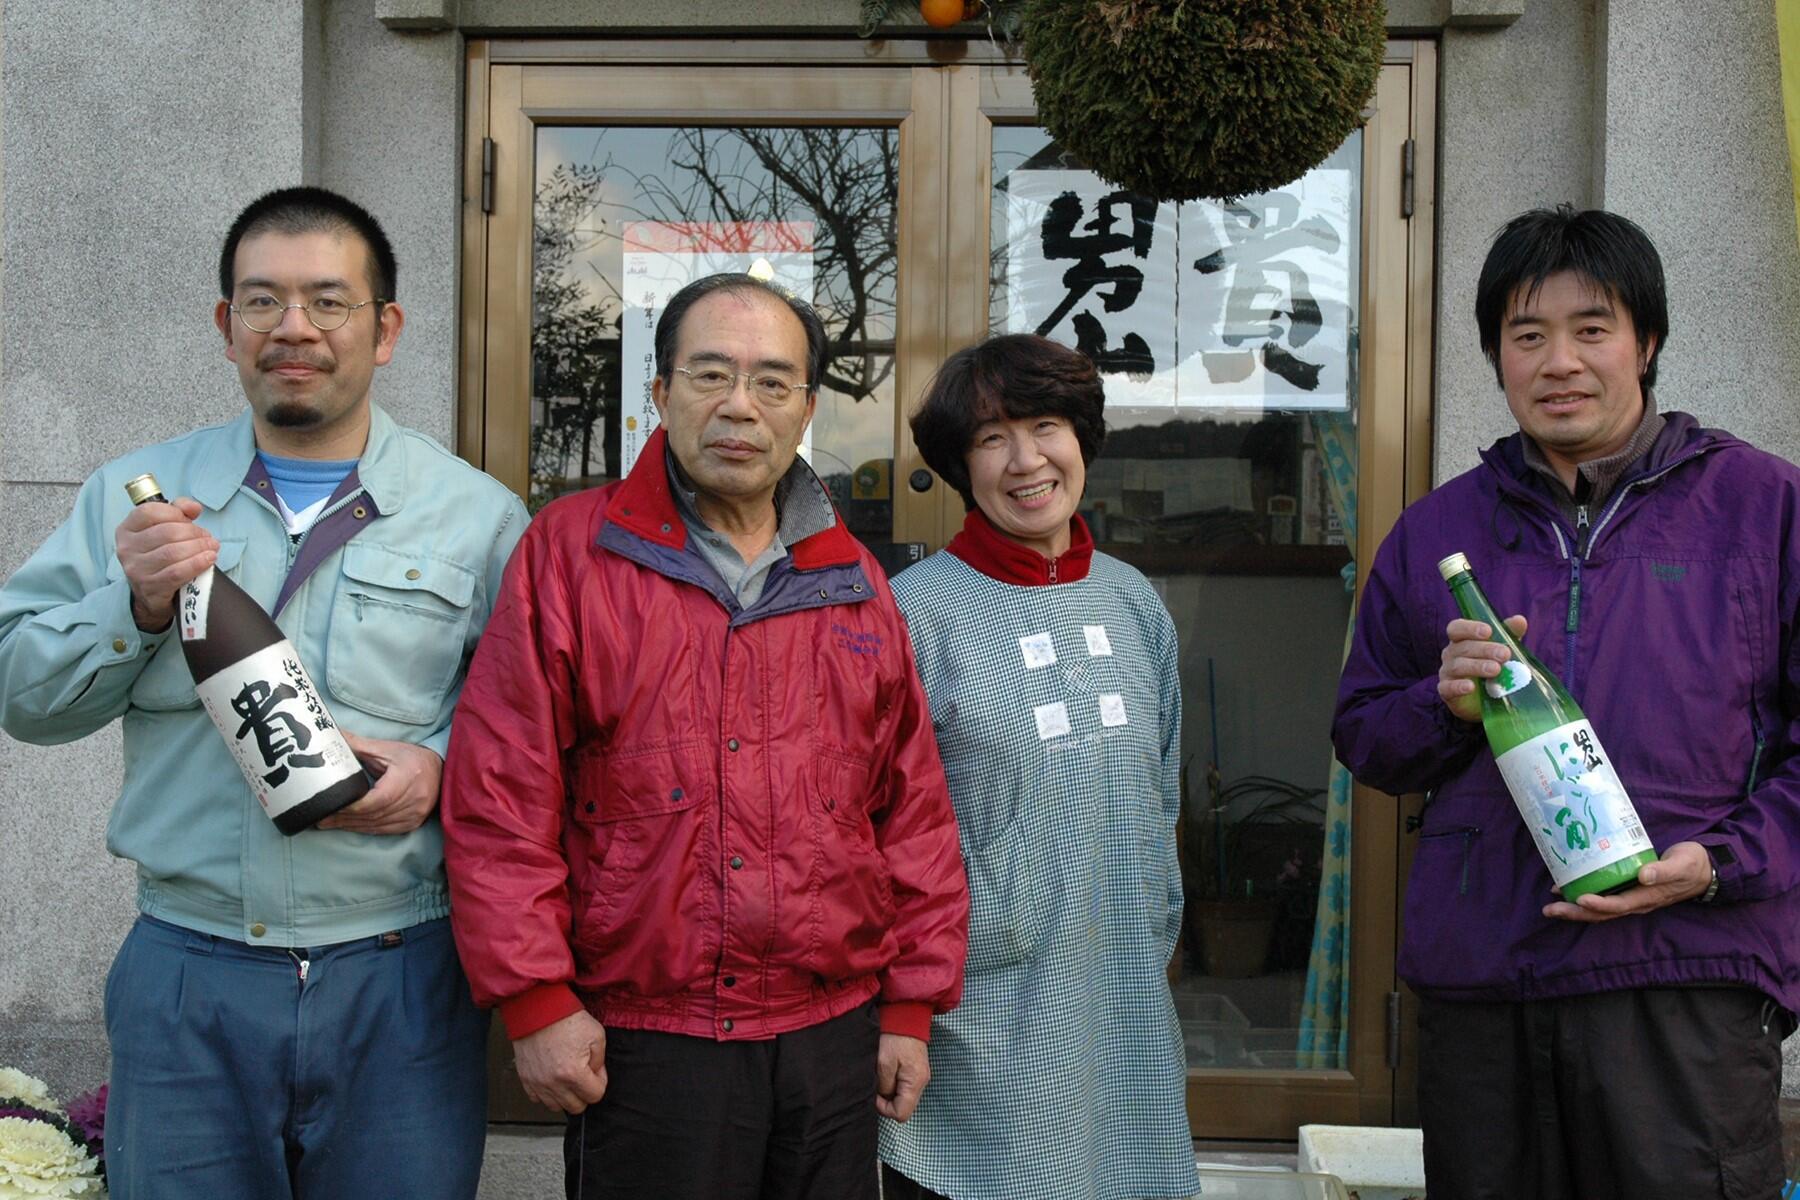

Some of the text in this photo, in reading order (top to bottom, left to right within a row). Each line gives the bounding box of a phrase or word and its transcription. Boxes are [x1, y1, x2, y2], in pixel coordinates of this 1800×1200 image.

[1035, 190, 1158, 383] 男山
[1193, 193, 1341, 391] 貴
[909, 543, 924, 560] 引
[230, 680, 326, 789] 貴
[282, 658, 335, 732] 純米大吟醸
[1573, 728, 1603, 772] 男山
